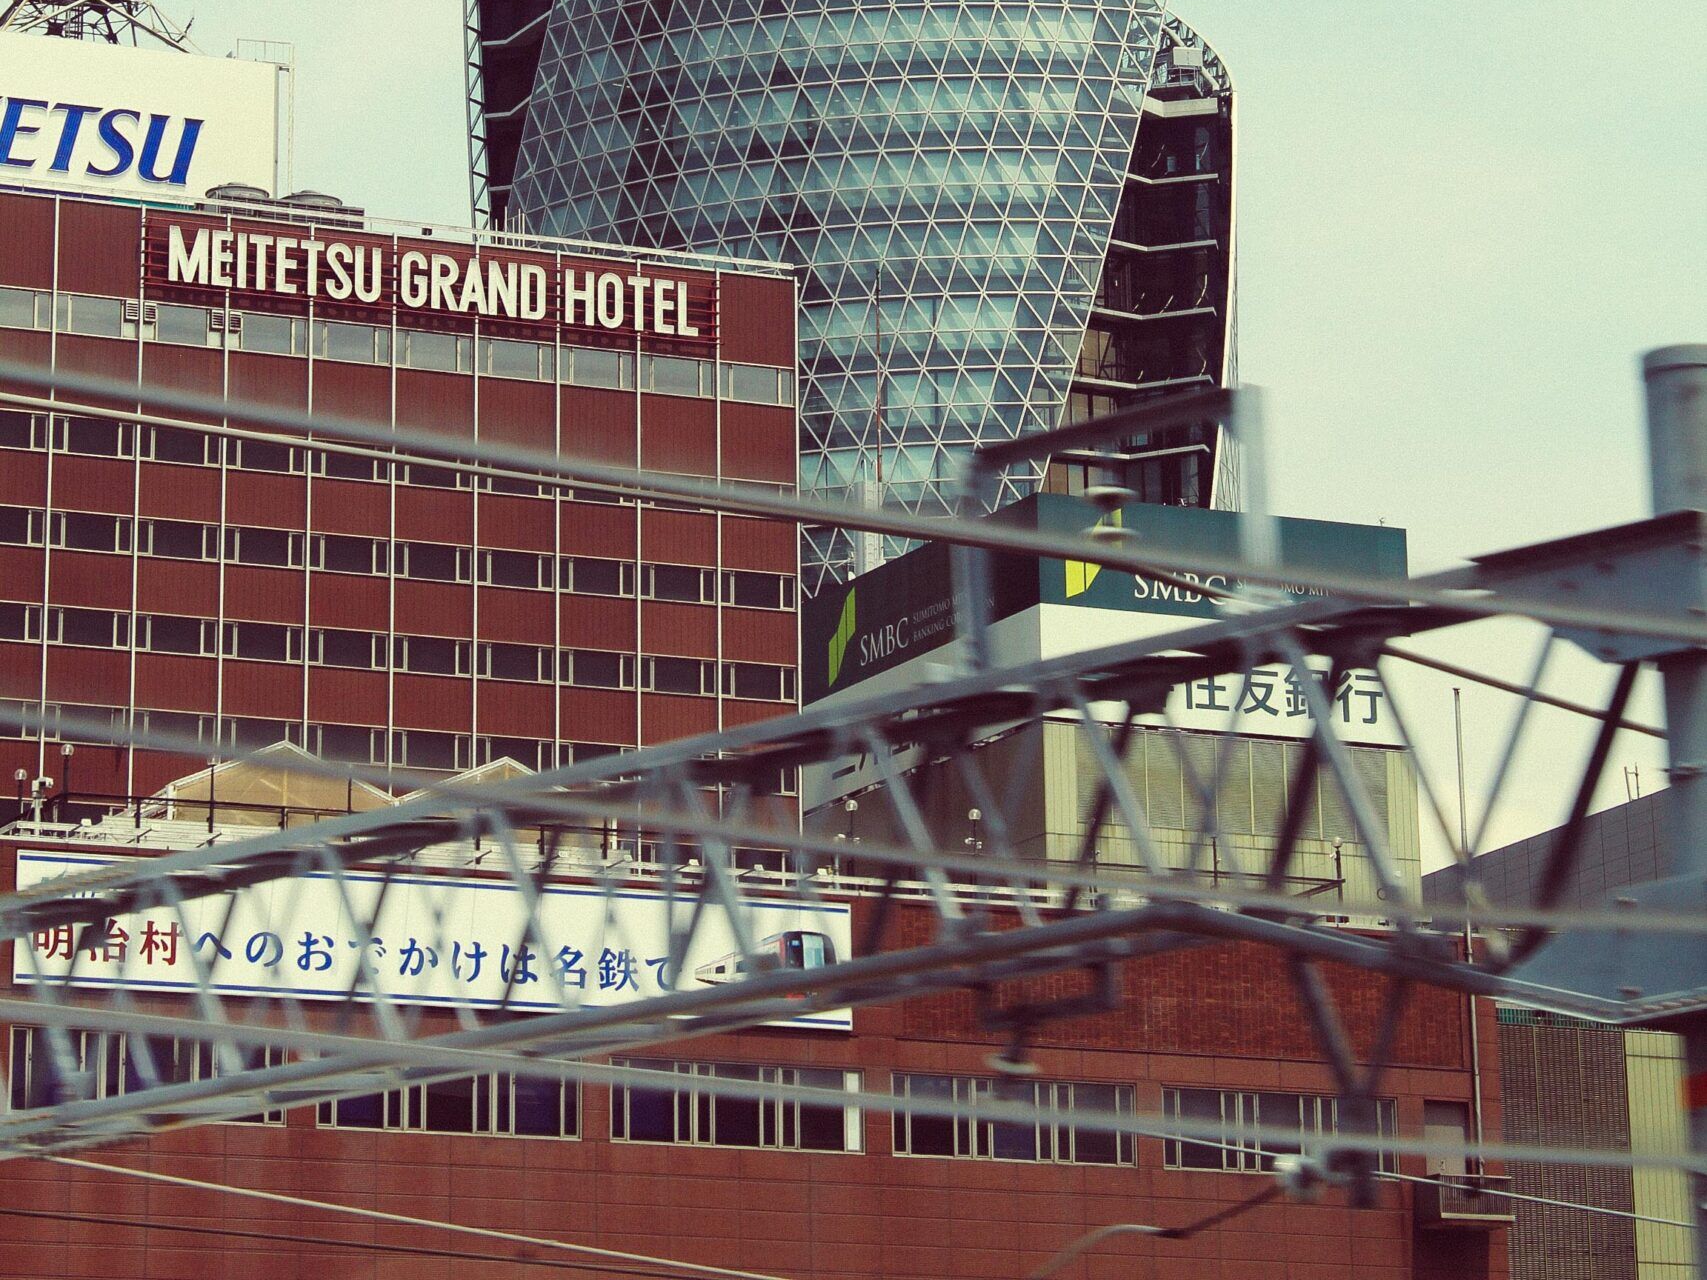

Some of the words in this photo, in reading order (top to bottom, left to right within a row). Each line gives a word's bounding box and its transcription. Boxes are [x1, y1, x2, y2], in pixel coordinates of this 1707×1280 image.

[0, 95, 205, 185] ETSU
[168, 225, 382, 303] MEITETSU
[401, 251, 547, 321] GRAND
[565, 269, 699, 337] HOTEL
[1135, 573, 1227, 605] SMBC
[860, 617, 909, 666] SMBC
[1168, 668, 1385, 725] 住友銀行
